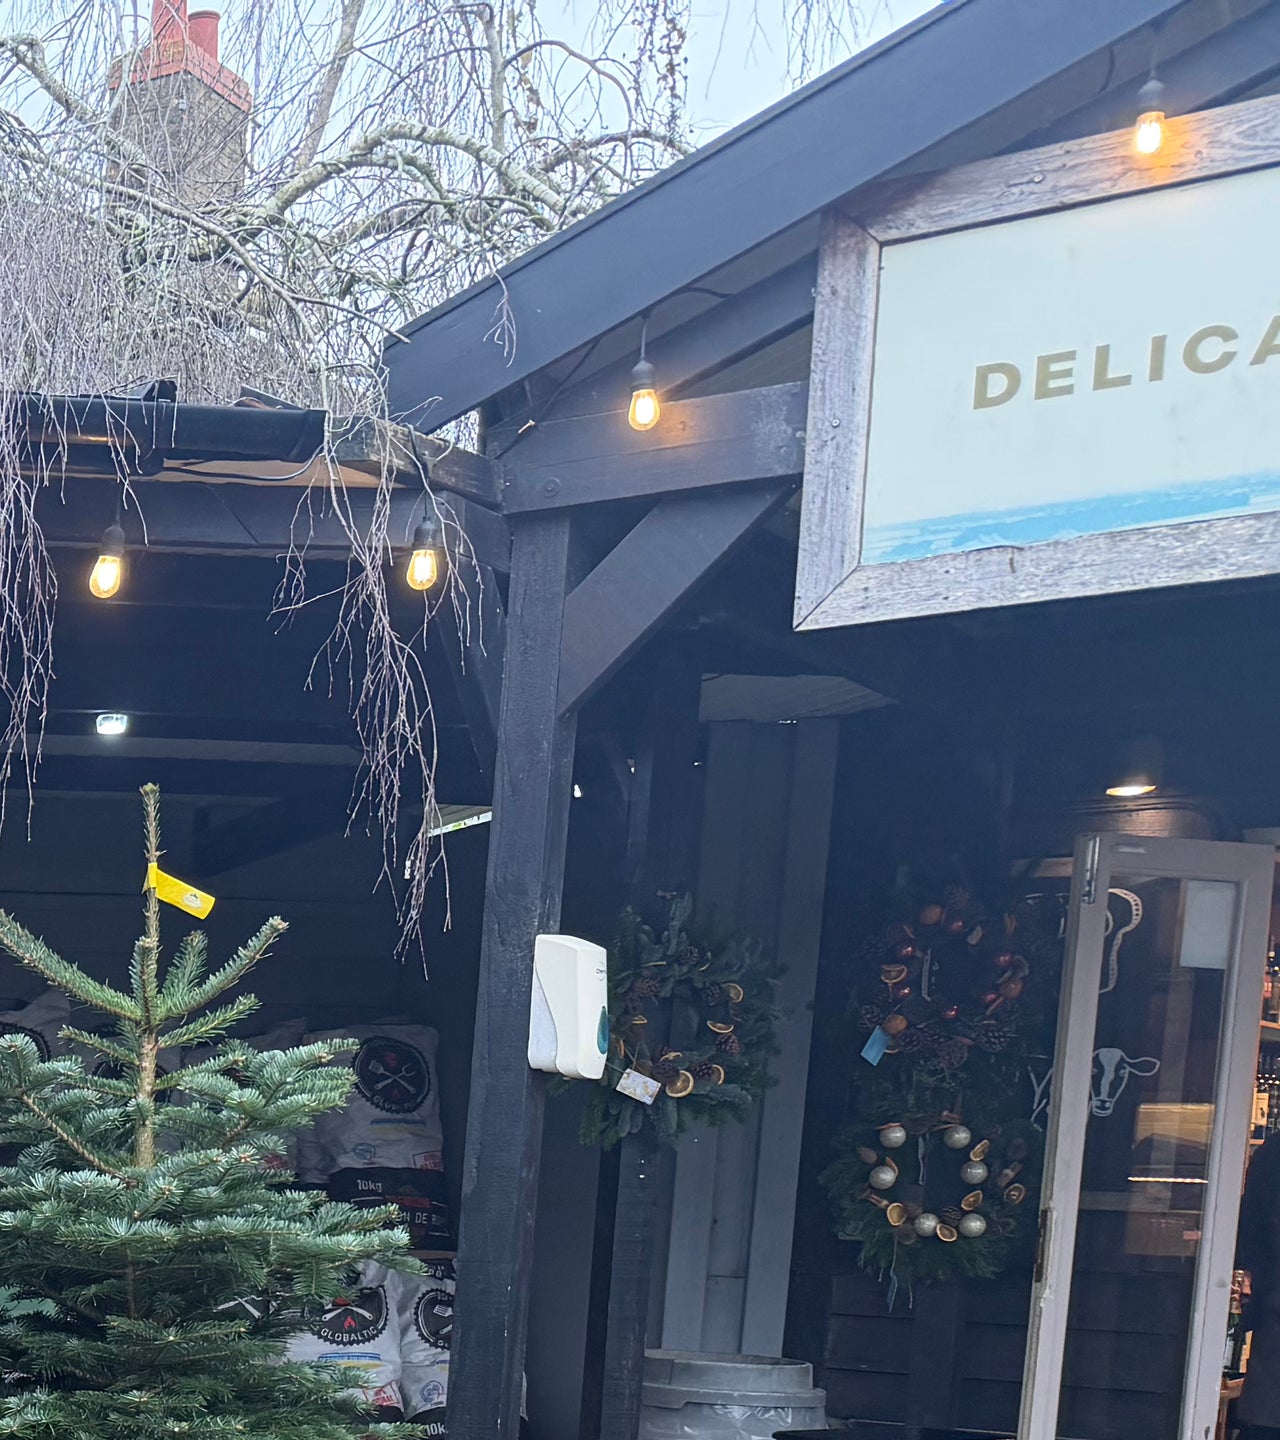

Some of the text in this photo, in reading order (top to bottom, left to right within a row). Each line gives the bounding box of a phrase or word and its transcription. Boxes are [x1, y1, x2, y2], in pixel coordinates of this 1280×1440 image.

[356, 1178, 383, 1193] 10kg
[415, 1211, 428, 1225] DE
[320, 1325, 378, 1343] GLOBALTIC
[425, 1423, 448, 1437] 10k
